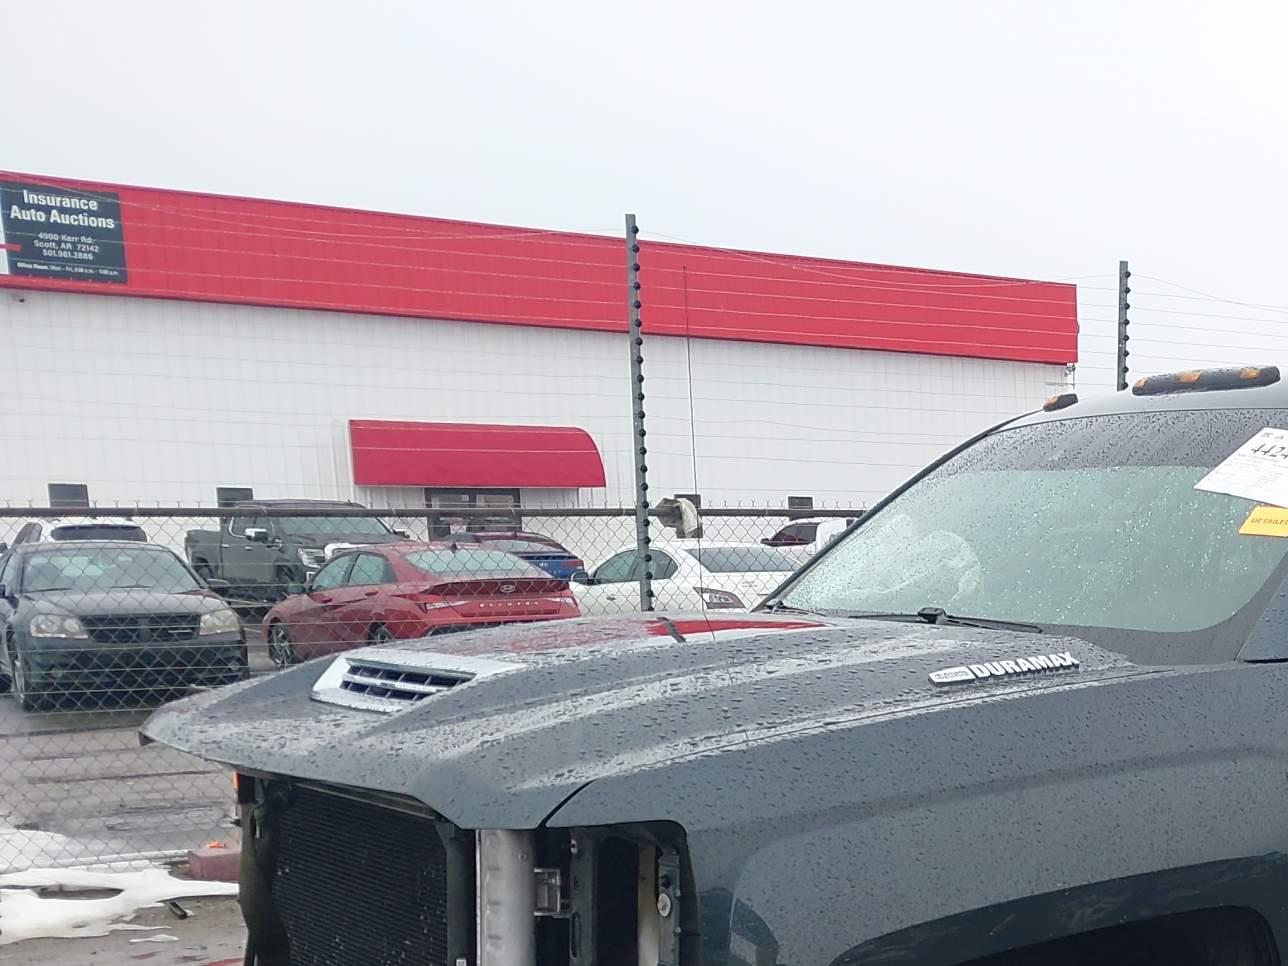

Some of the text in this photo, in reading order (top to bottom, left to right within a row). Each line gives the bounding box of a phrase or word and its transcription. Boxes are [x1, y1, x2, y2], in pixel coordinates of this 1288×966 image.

[22, 188, 99, 211] Insurance
[10, 204, 116, 229] Auto Auctions
[33, 239, 99, 253] Scott, AR 72142
[968, 652, 1081, 679] DURAMAX
